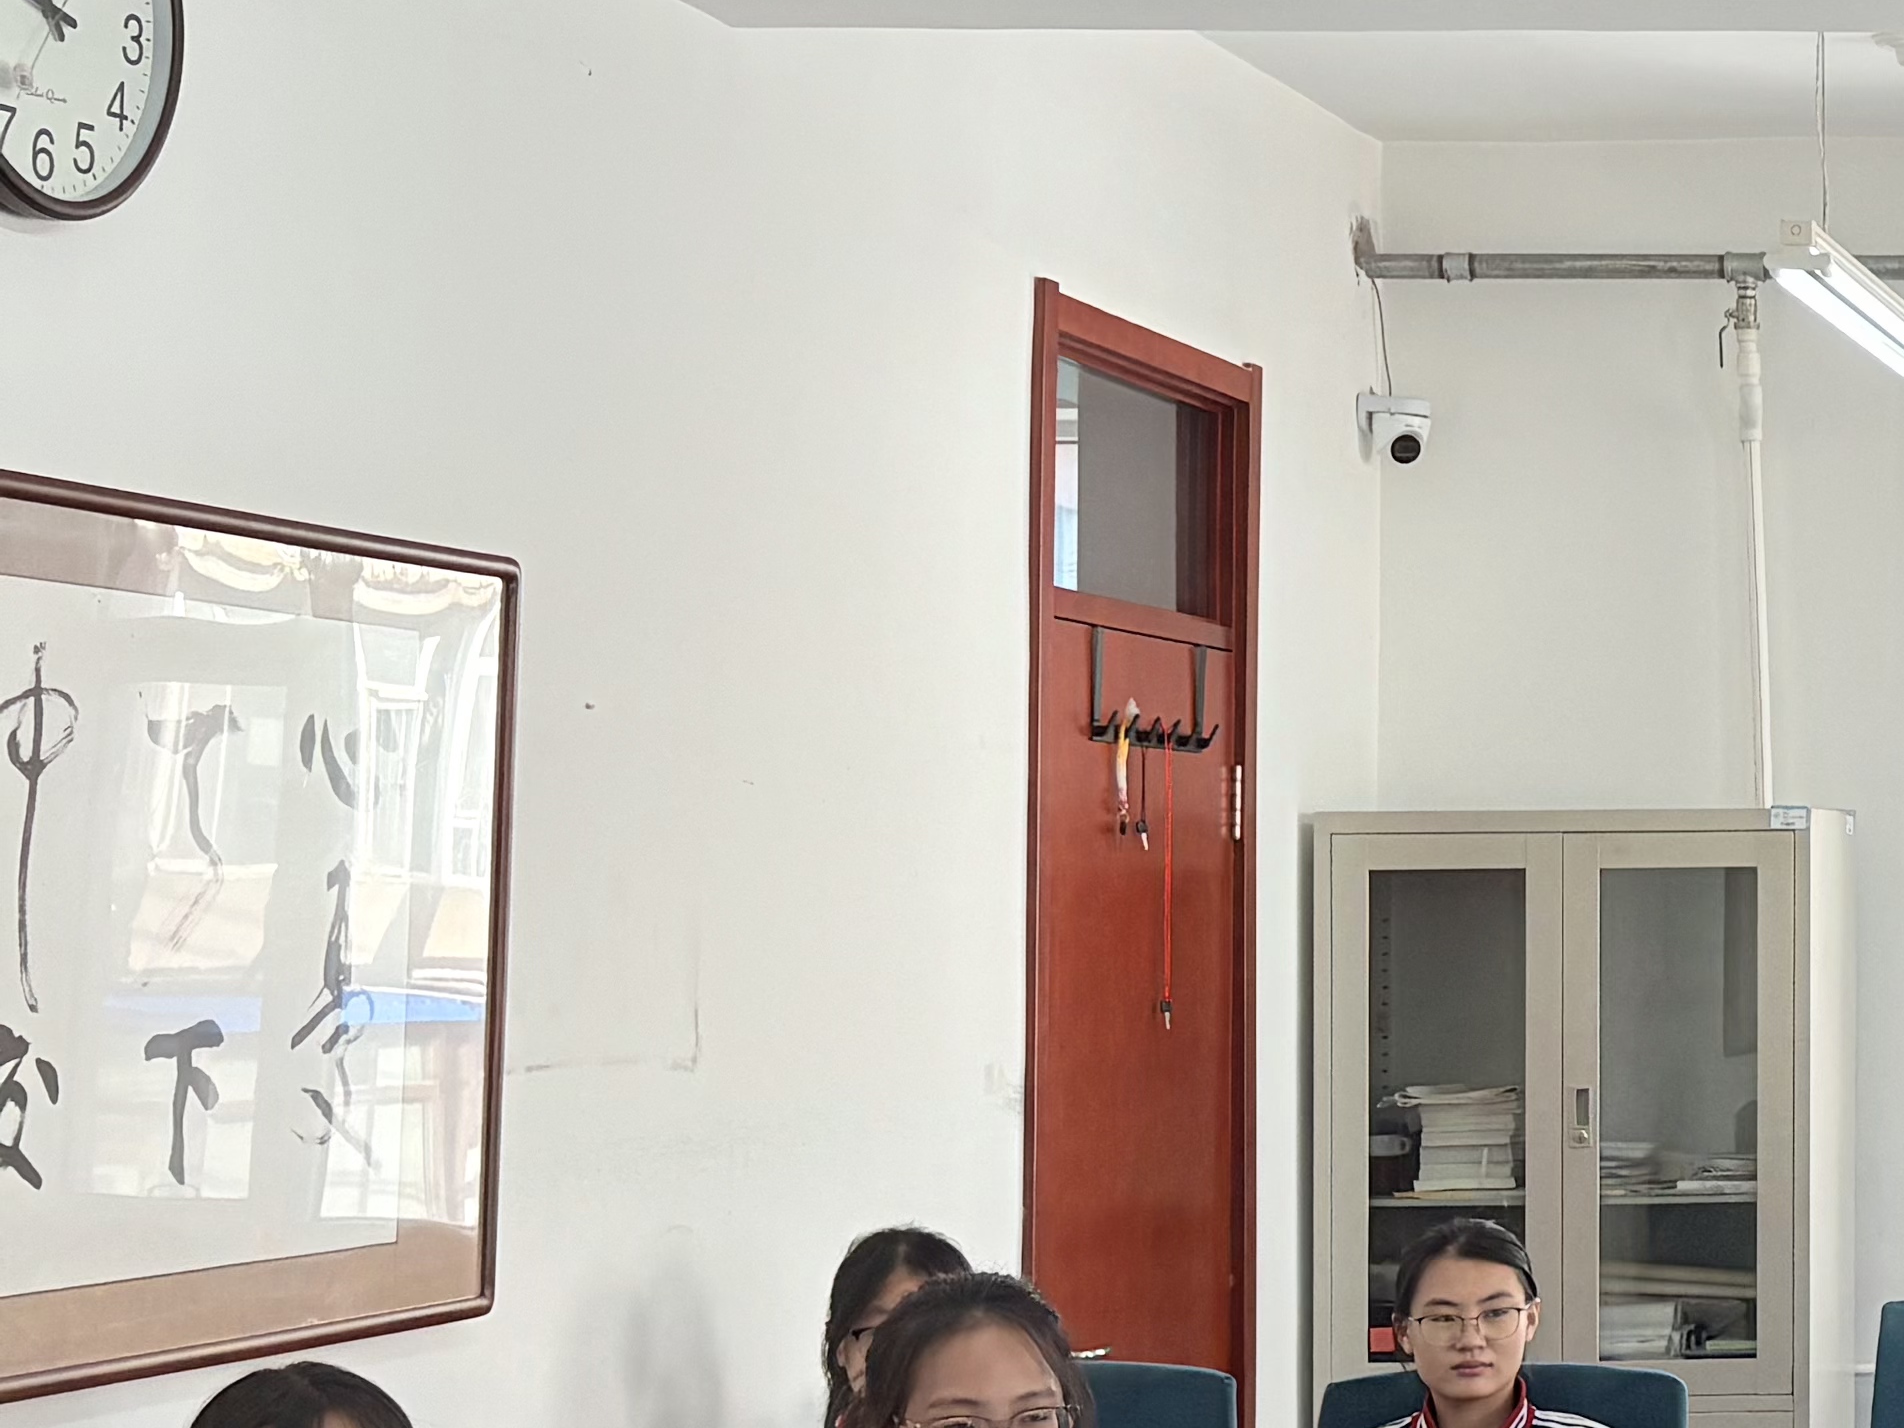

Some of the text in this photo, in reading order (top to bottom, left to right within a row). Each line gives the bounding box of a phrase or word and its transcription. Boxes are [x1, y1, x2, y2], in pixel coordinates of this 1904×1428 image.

[121, 14, 144, 66] 3
[106, 81, 129, 132] 4
[32, 128, 55, 181] 6
[73, 122, 95, 174] 5
